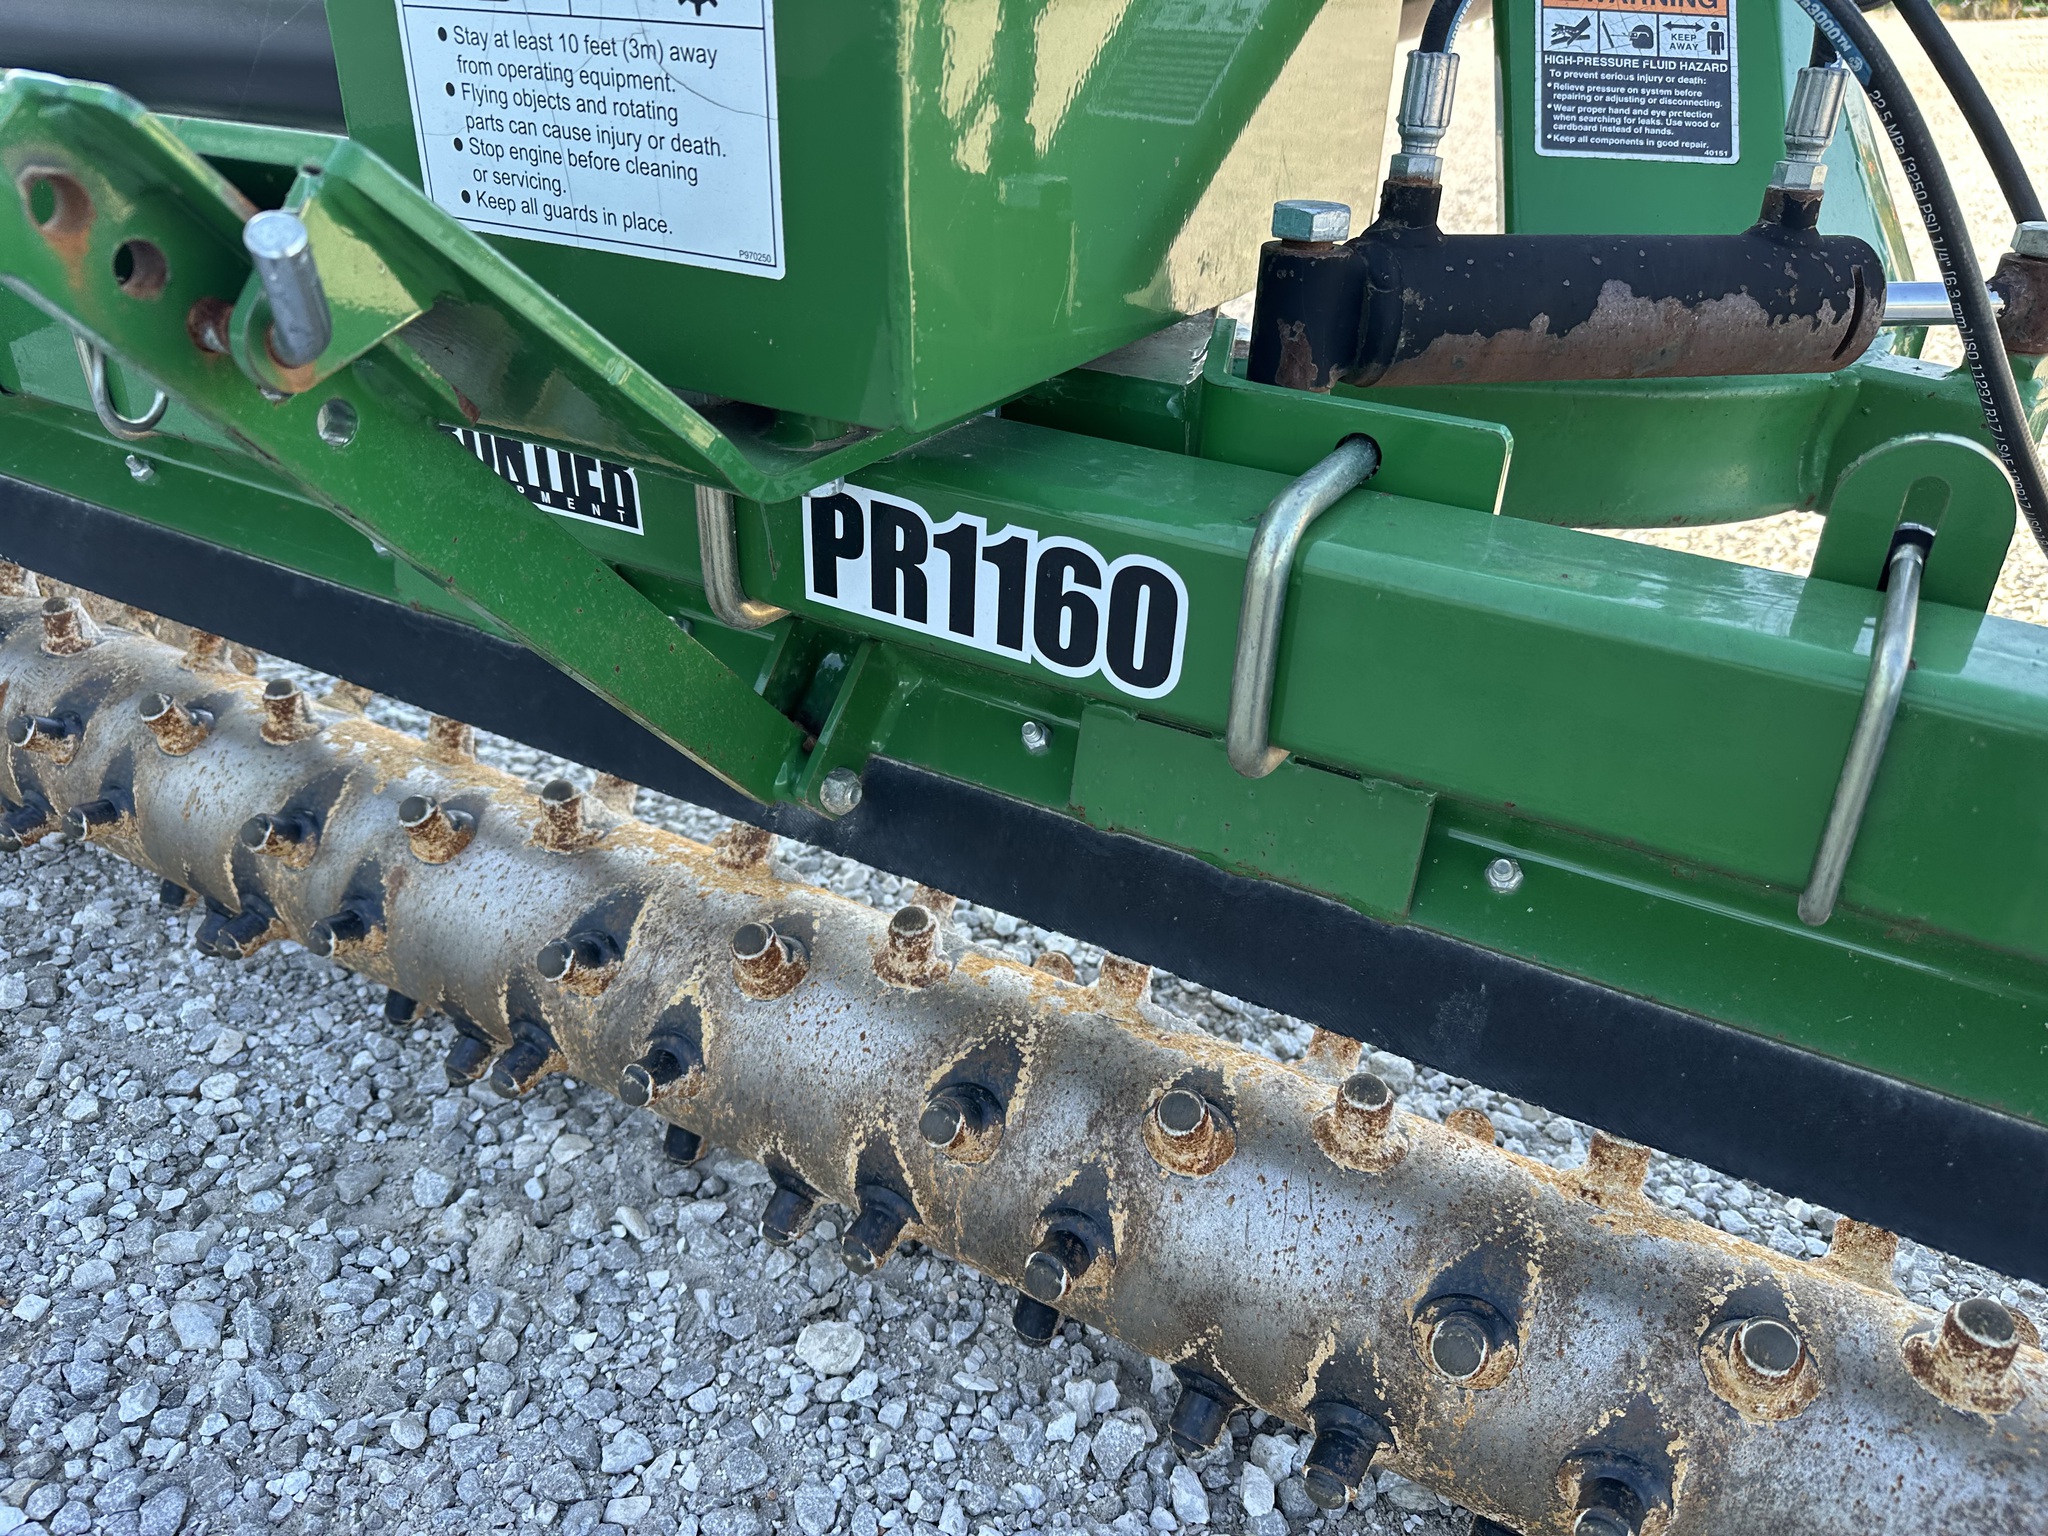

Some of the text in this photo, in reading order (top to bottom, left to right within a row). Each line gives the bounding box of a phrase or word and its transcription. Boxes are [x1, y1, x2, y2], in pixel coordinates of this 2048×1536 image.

[453, 25, 718, 70] Stay at least 10 feet (3m) away
[1669, 42, 1699, 51] AWAY
[1671, 33, 1697, 42] KEEP
[456, 54, 676, 92] from operating equipment.
[1544, 55, 1728, 73] HIGH-PRESSURE FLUID HAZARD
[1549, 69, 1561, 77] To
[1563, 70, 1598, 79] prevent
[1600, 72, 1635, 81] serious
[1637, 74, 1663, 84] injury
[1677, 76, 1707, 84] death:
[1553, 82, 1585, 91] Relieve
[1586, 85, 1625, 93] pressure
[1640, 87, 1672, 96] system
[1674, 88, 1702, 97] before
[1553, 92, 1592, 103] repairing
[1605, 94, 1646, 105] adjusting
[1659, 97, 1723, 109] disconnecting.
[461, 82, 678, 127] Flying objects and rotating
[1553, 103, 1713, 119] Wear proper hand and eye protection
[1553, 113, 1576, 122] when
[1578, 115, 1621, 125] searching
[1623, 116, 1635, 125] for
[1637, 117, 1663, 126] leaks.
[1665, 118, 1683, 127] Use
[1684, 119, 1709, 128] wood
[1553, 123, 1674, 135] cardboard instead of hands.
[465, 114, 727, 158] parts can cause injury or death.
[1553, 134, 1709, 150] Keep all components in good repair.
[1886, 123, 1905, 156] MPa
[469, 136, 698, 187] Stop engine before cleaning
[1703, 149, 1728, 157] 40151
[473, 168, 567, 197] or servicing.
[476, 190, 673, 235] Keep all guards in place.
[738, 250, 772, 263] P970250
[1964, 337, 1979, 360] ISO
[1970, 363, 1994, 406] 11237
[1984, 408, 2003, 433] R17
[1996, 443, 2014, 466] SAE
[810, 492, 1179, 689] PR1160
